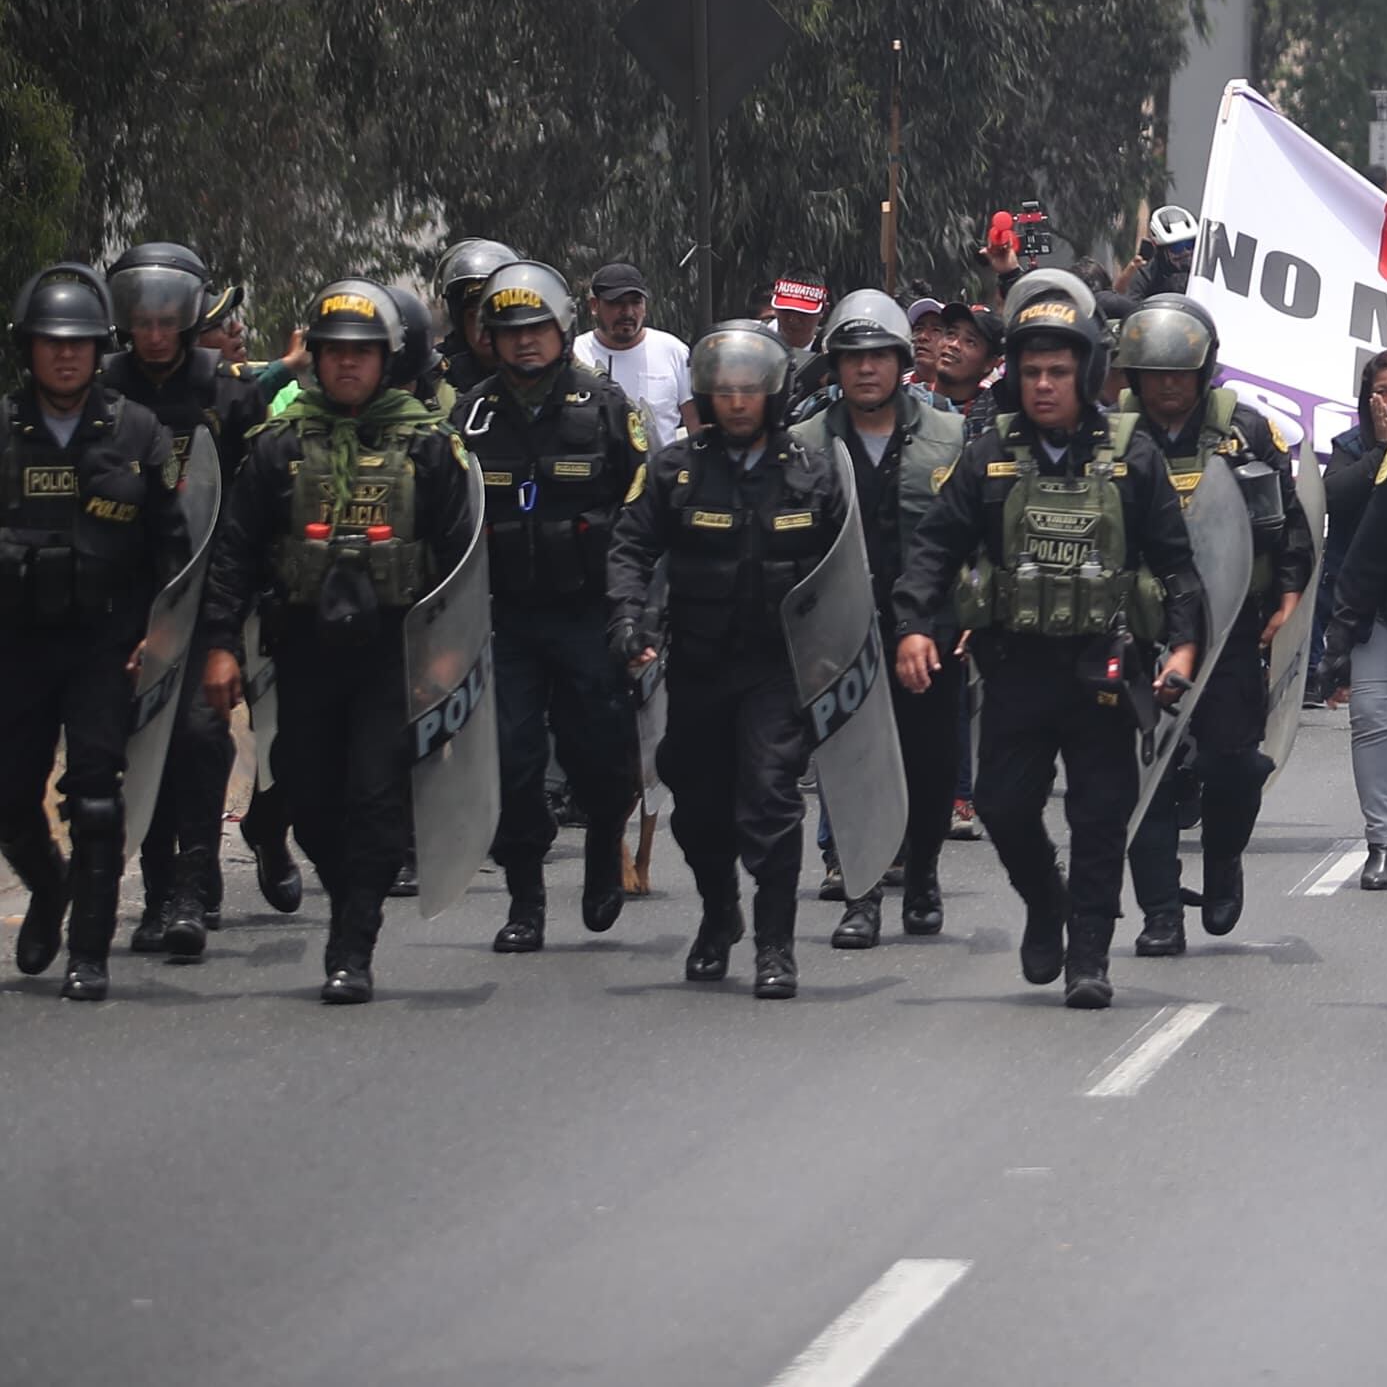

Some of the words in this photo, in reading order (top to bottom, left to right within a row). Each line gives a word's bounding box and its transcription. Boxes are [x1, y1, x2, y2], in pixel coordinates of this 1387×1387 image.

[1195, 218, 1321, 319] NO
[321, 295, 375, 317] POLICIA
[492, 287, 542, 312] POLICIA
[1018, 303, 1076, 325] POLICIA
[1028, 539, 1088, 563] POLICIA
